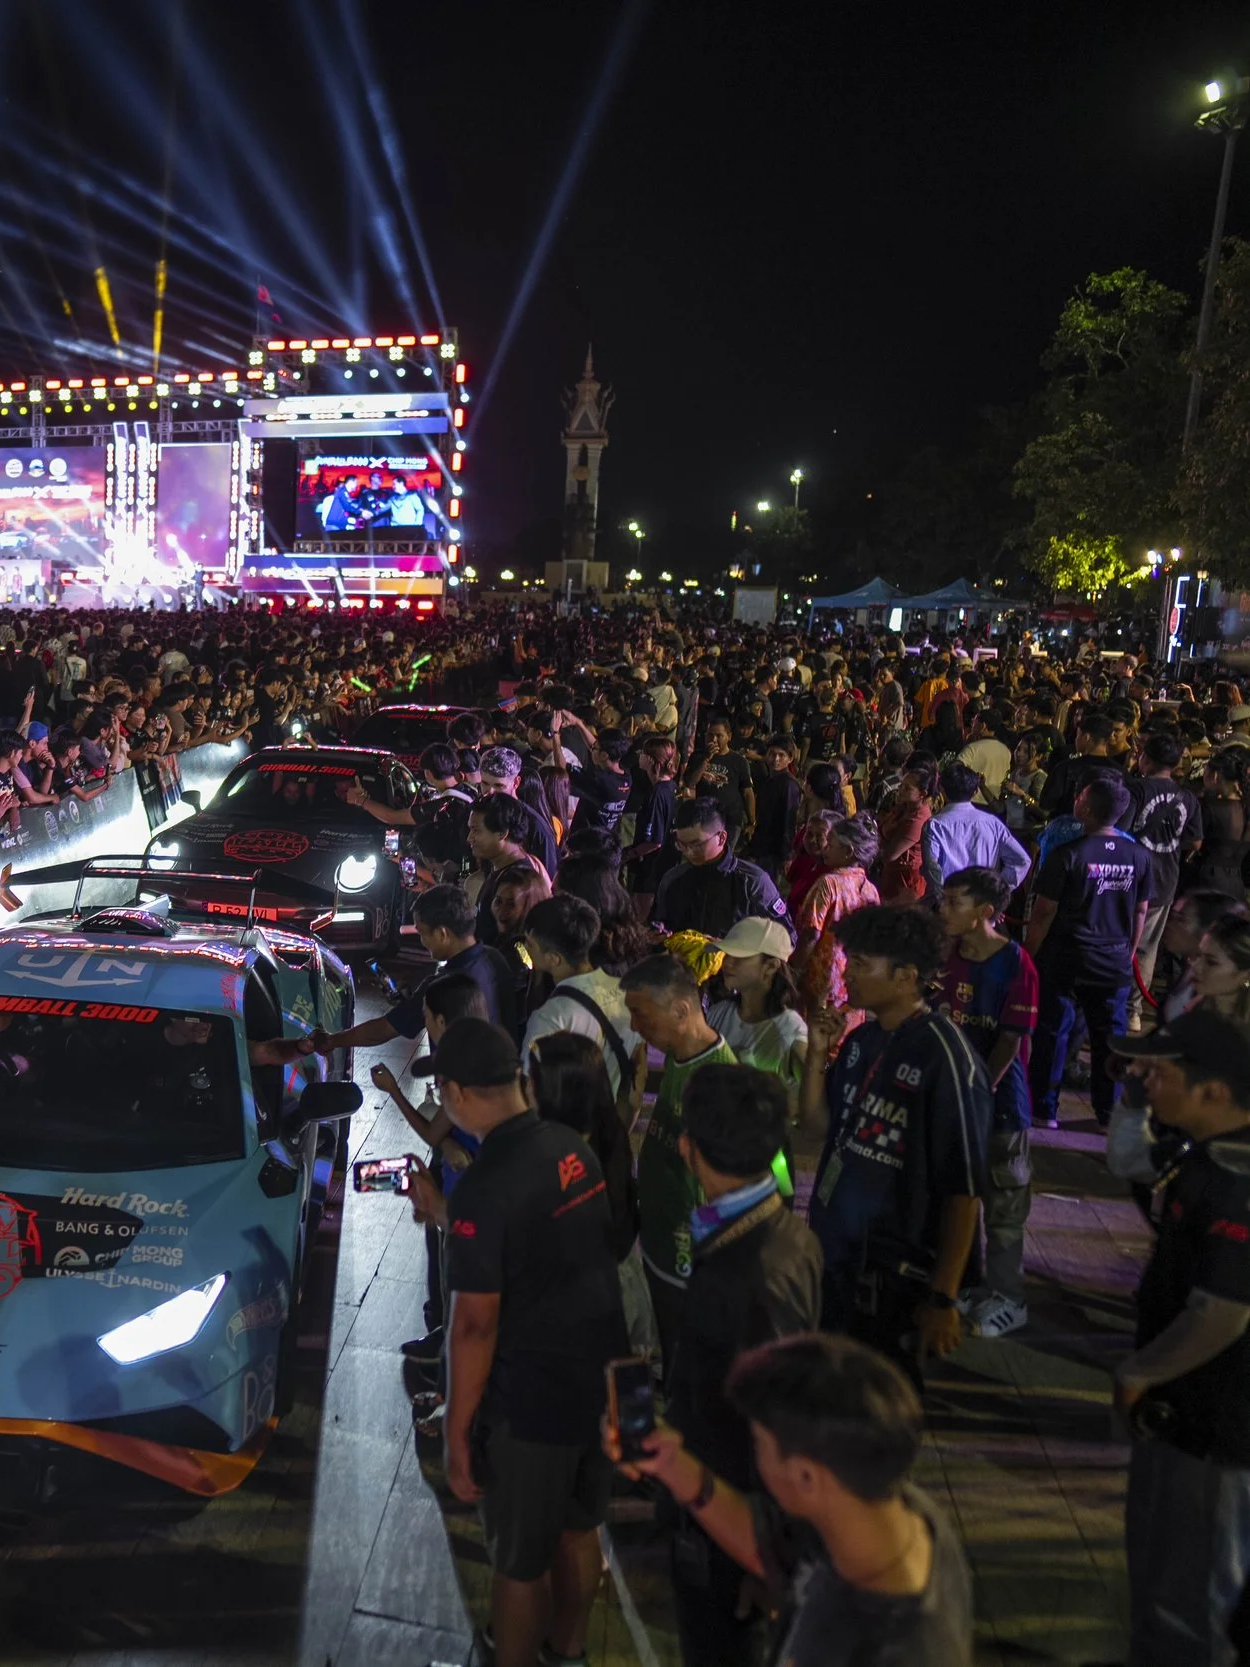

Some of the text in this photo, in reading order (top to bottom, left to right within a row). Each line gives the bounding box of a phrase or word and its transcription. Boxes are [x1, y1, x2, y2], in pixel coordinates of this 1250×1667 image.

[258, 763, 358, 777] GUMBALL 3000
[79, 1004, 160, 1024] 3000
[895, 1063, 923, 1086] 08
[60, 1186, 128, 1210] Hard
[55, 1220, 189, 1237] BANG & OLUFSEN
[132, 1244, 184, 1258] MONG
[131, 1255, 183, 1268] GROUP
[117, 1275, 182, 1294] NARDIN
